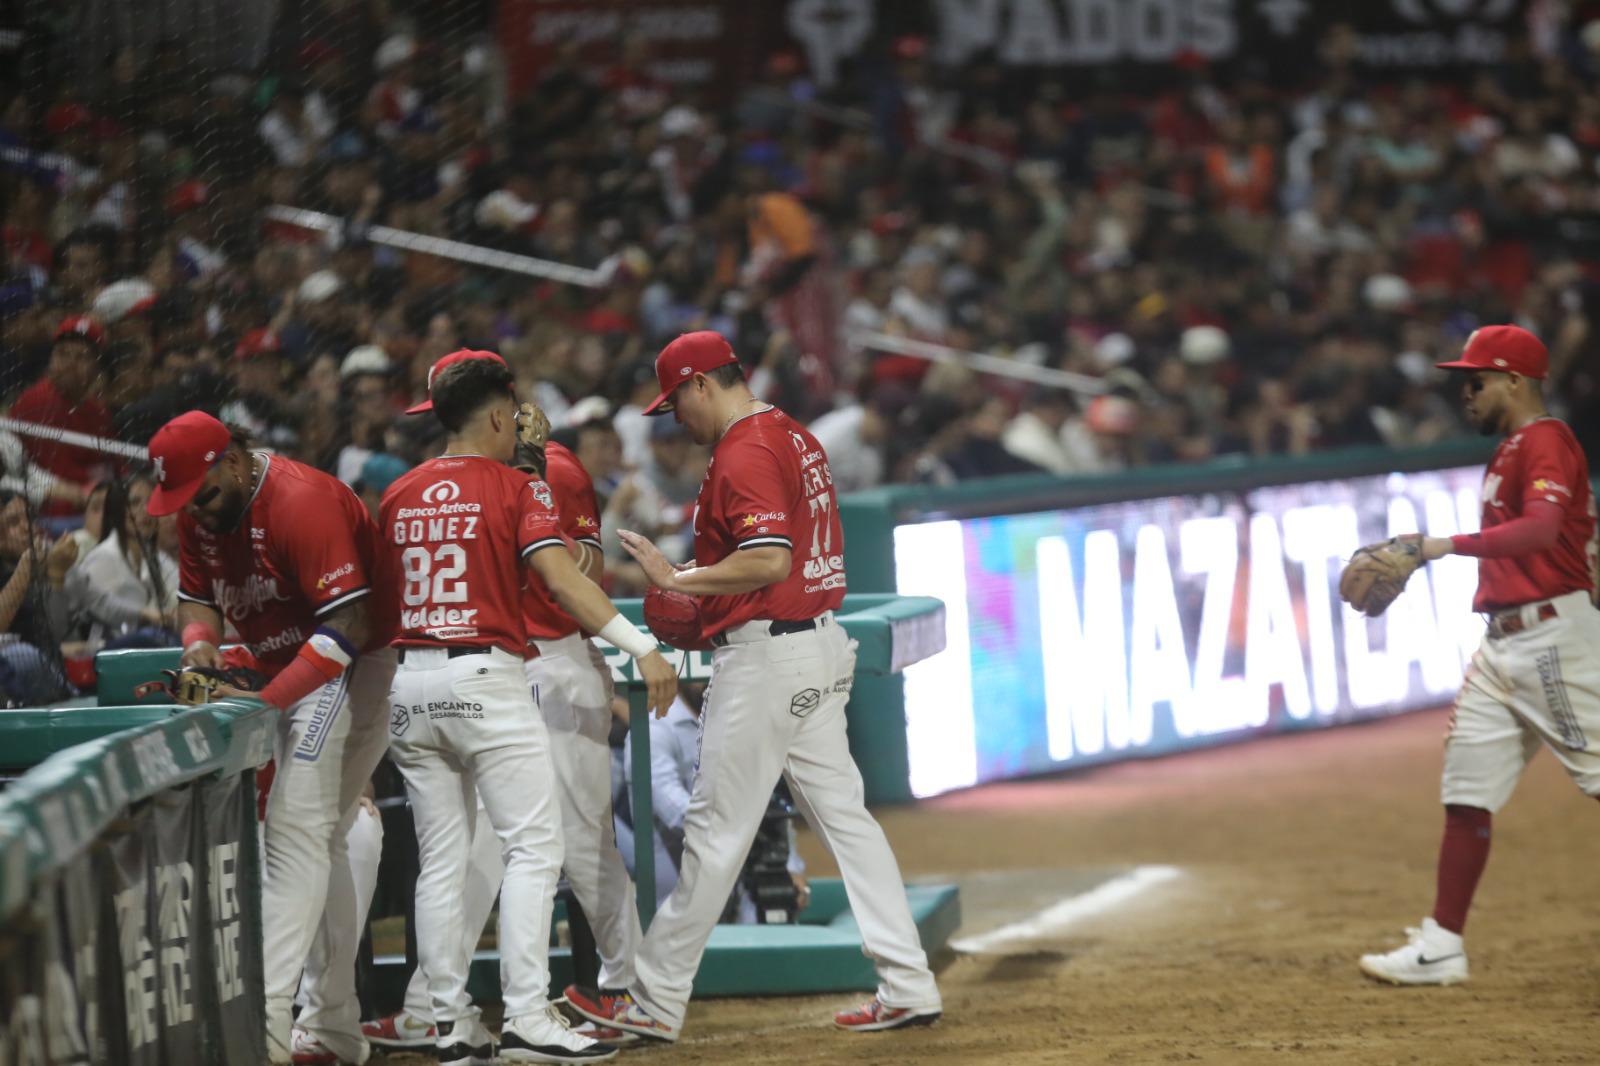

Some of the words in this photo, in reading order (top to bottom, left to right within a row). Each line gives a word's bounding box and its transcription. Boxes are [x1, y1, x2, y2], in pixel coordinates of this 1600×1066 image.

[397, 507, 436, 519] Banco
[437, 503, 481, 514] Azteca
[393, 516, 478, 544] GOMEZ
[401, 543, 468, 606] 82
[412, 705, 425, 715] EL
[428, 701, 483, 712] ENCANTO
